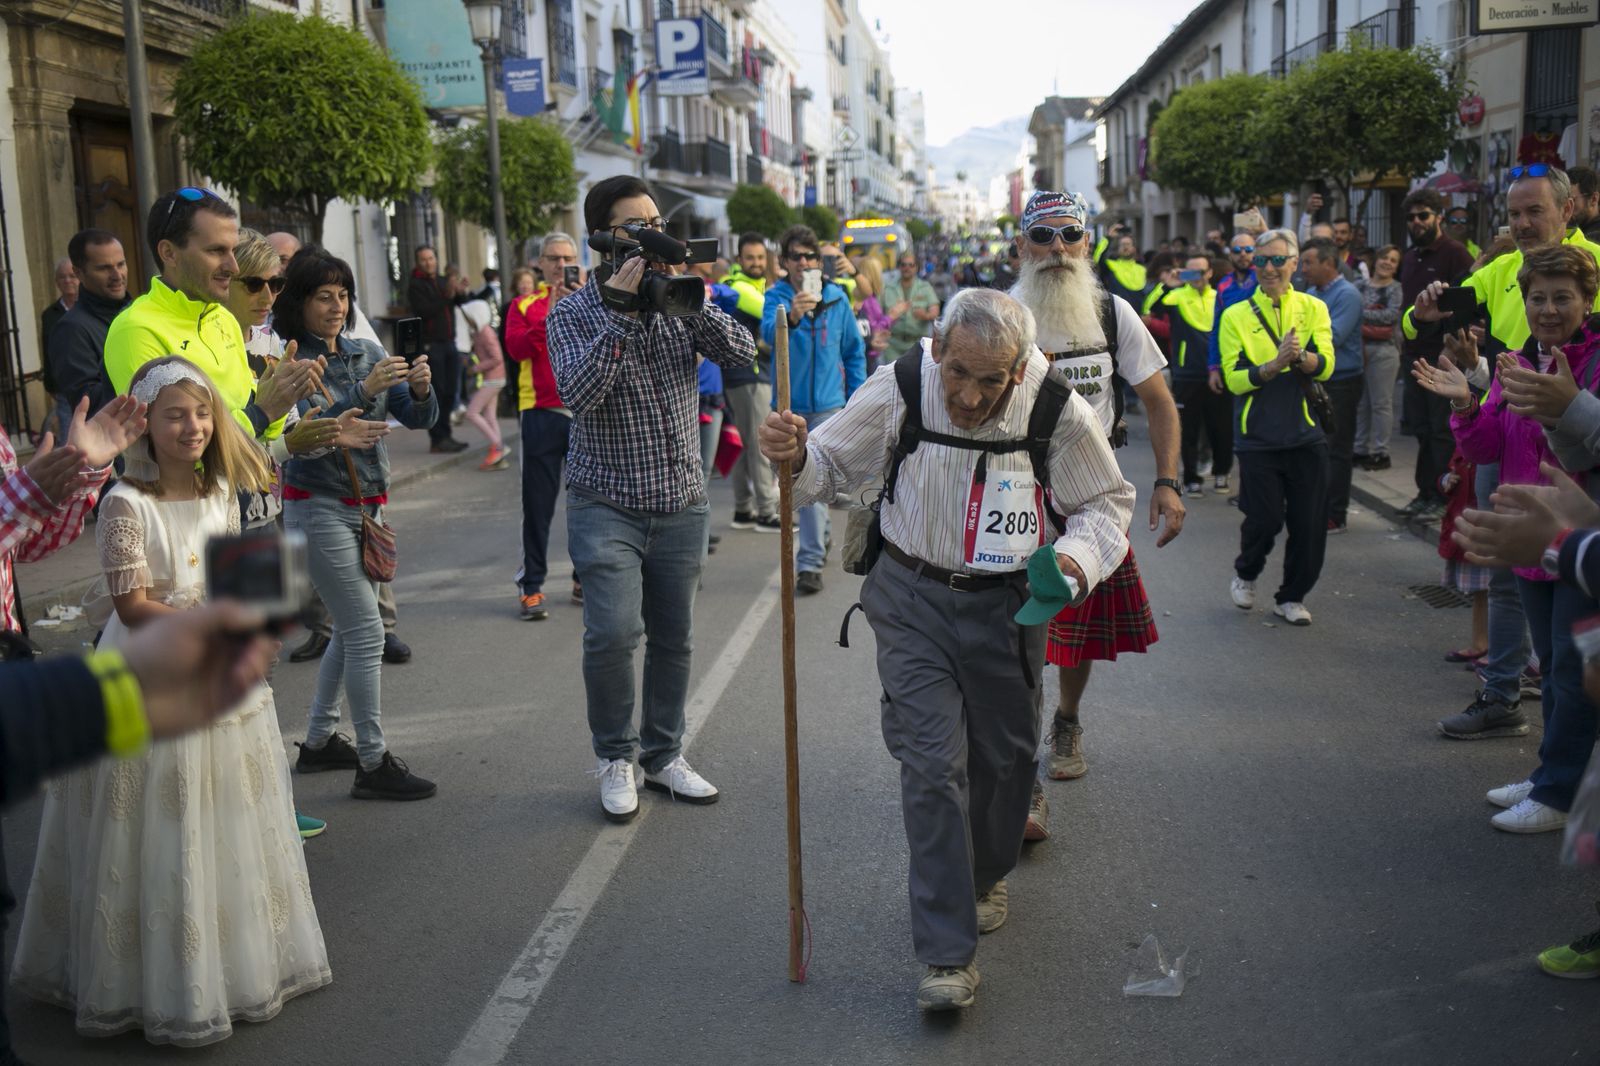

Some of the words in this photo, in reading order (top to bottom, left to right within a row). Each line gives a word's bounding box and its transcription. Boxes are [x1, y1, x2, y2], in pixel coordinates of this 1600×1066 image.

[1488, 5, 1538, 20] Decoración
[1552, 2, 1590, 16] Muebles
[400, 59, 472, 71] RESTAURANTE
[985, 510, 1038, 535] 2809
